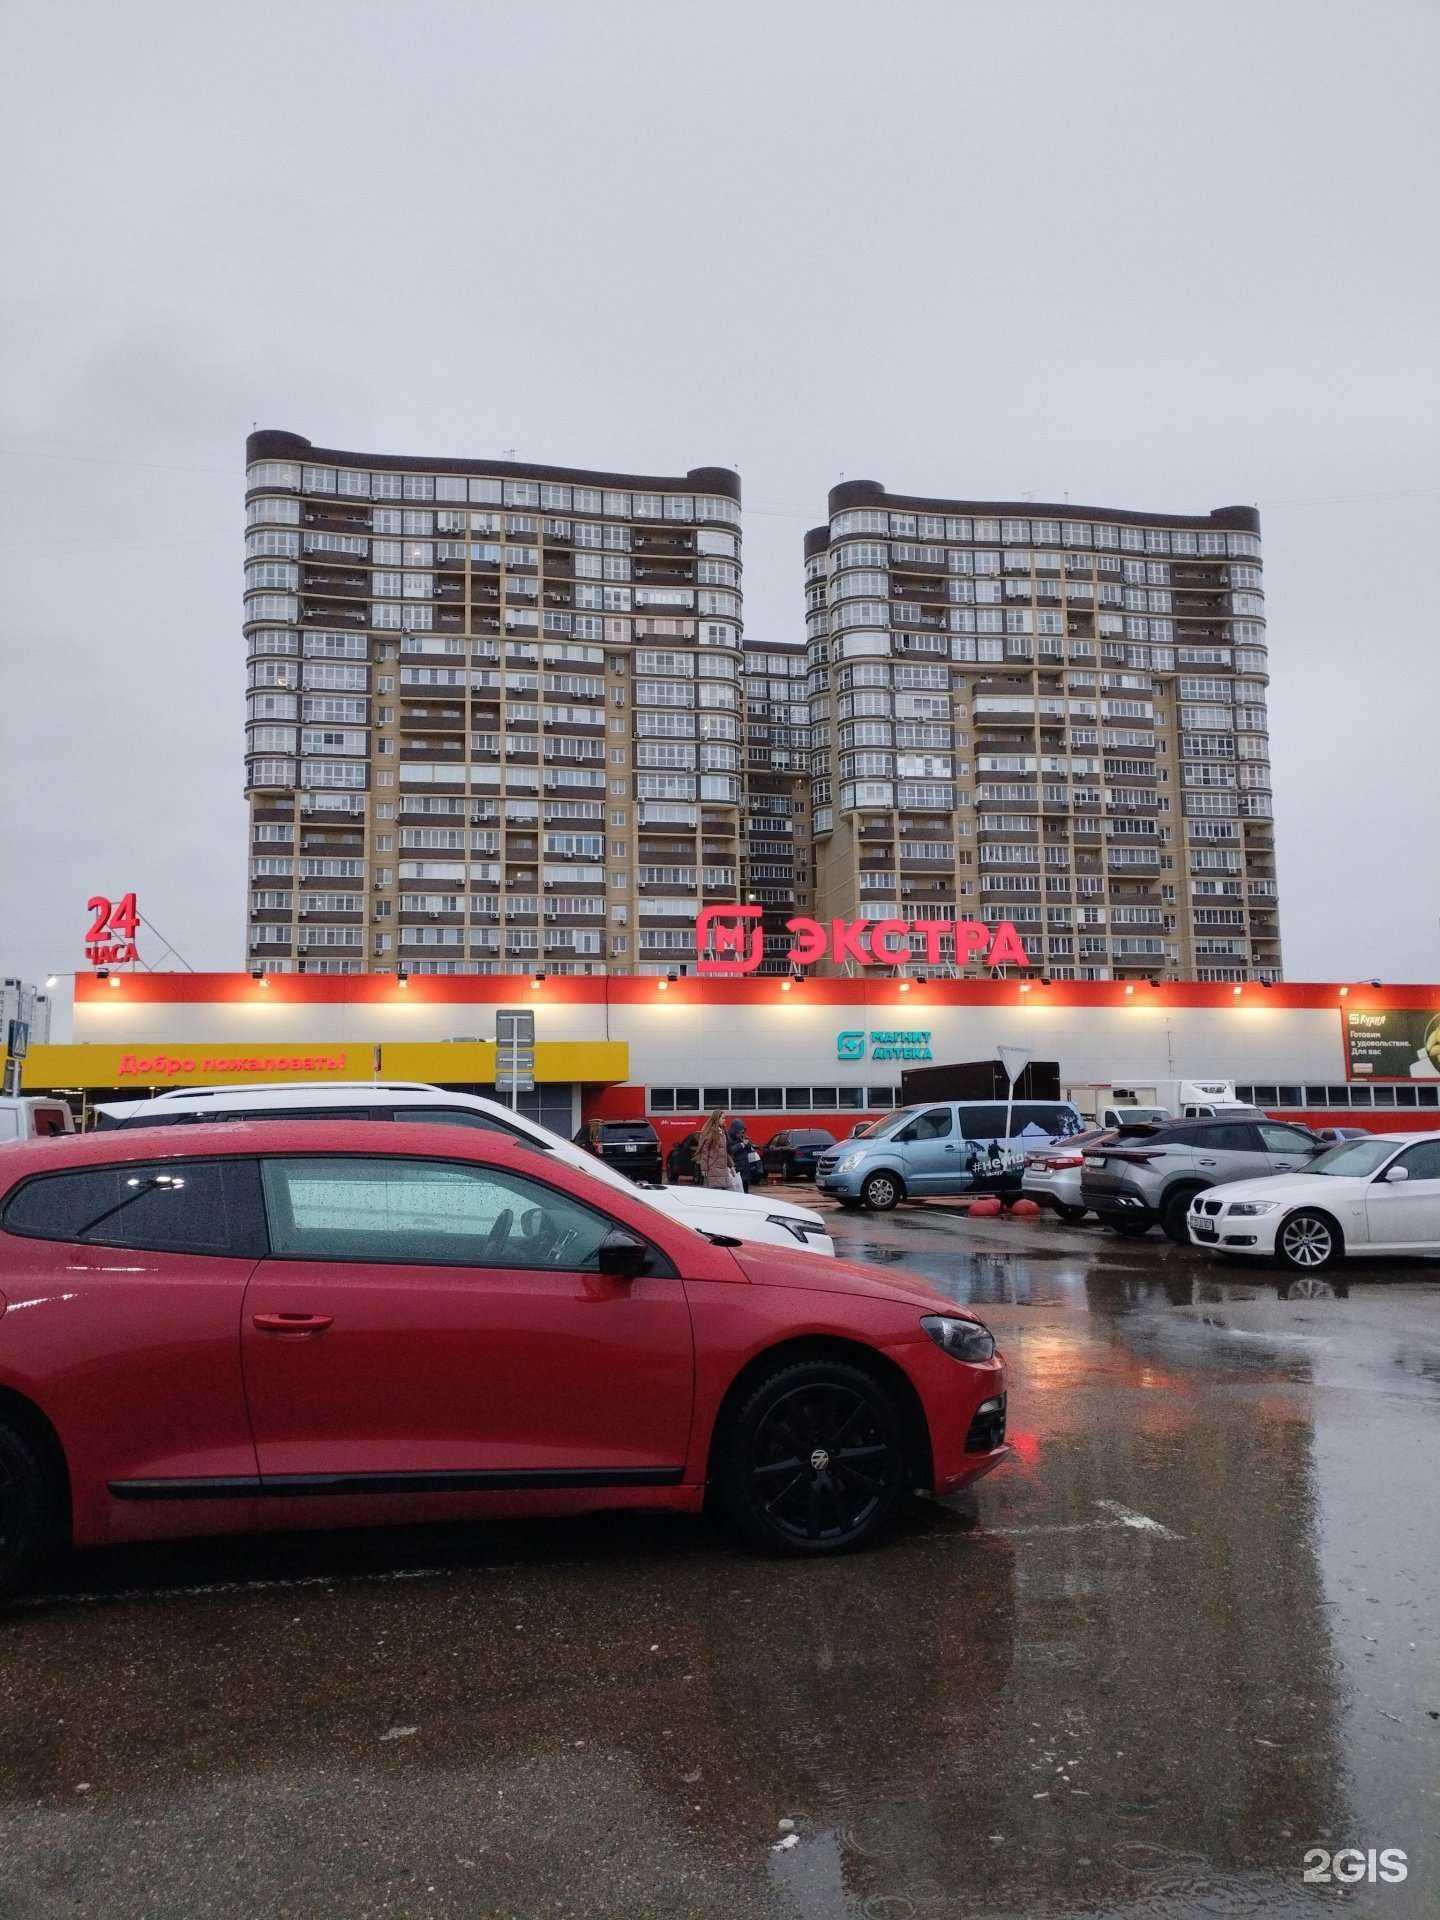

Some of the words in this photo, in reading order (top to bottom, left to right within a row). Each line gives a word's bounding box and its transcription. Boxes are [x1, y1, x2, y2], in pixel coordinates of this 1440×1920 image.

[86, 893, 140, 942] 24
[786, 918, 1030, 967] ЭКСТРА
[85, 943, 140, 965] ЧАСА
[871, 1031, 931, 1044] МАГНИТ
[117, 1054, 196, 1076] Добро
[200, 1053, 346, 1072] пожаловать!
[872, 1047, 933, 1060] АПТЕКА
